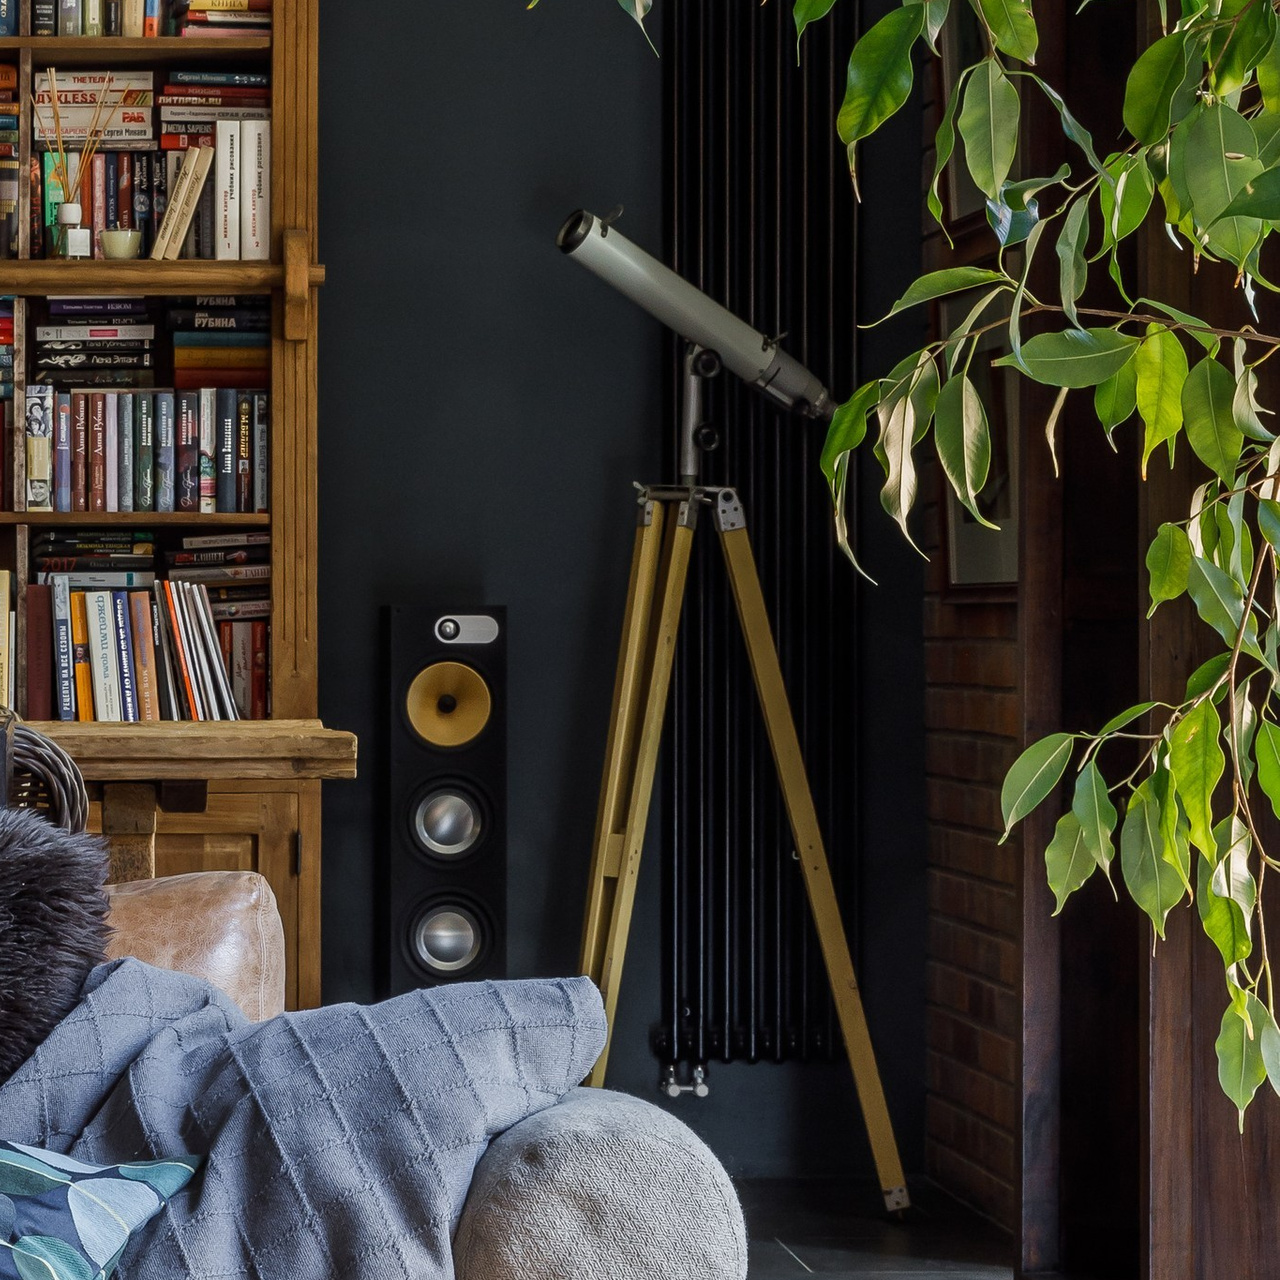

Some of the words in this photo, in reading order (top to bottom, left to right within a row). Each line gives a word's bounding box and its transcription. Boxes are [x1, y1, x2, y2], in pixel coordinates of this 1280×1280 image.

[158, 97, 222, 105] ЛИТПРОМ.RU
[103, 129, 125, 137] Сергей
[125, 128, 147, 136] Минаев
[167, 124, 186, 134] MEDIA
[187, 124, 213, 134] SAPIENS
[194, 317, 236, 328] РУБИНА
[91, 356, 111, 364] Лена
[76, 400, 85, 430] Рубина
[93, 401, 103, 431] Рубина
[221, 453, 232, 474] Галина
[41, 558, 77, 572] 2017
[59, 625, 68, 653] СЕЗОНЫ
[94, 595, 107, 650] джейми
[101, 652, 110, 679] дома
[60, 654, 69, 667] ВСЕ
[61, 668, 69, 678] НА
[62, 680, 71, 711] РЕЦЕПТЫ
